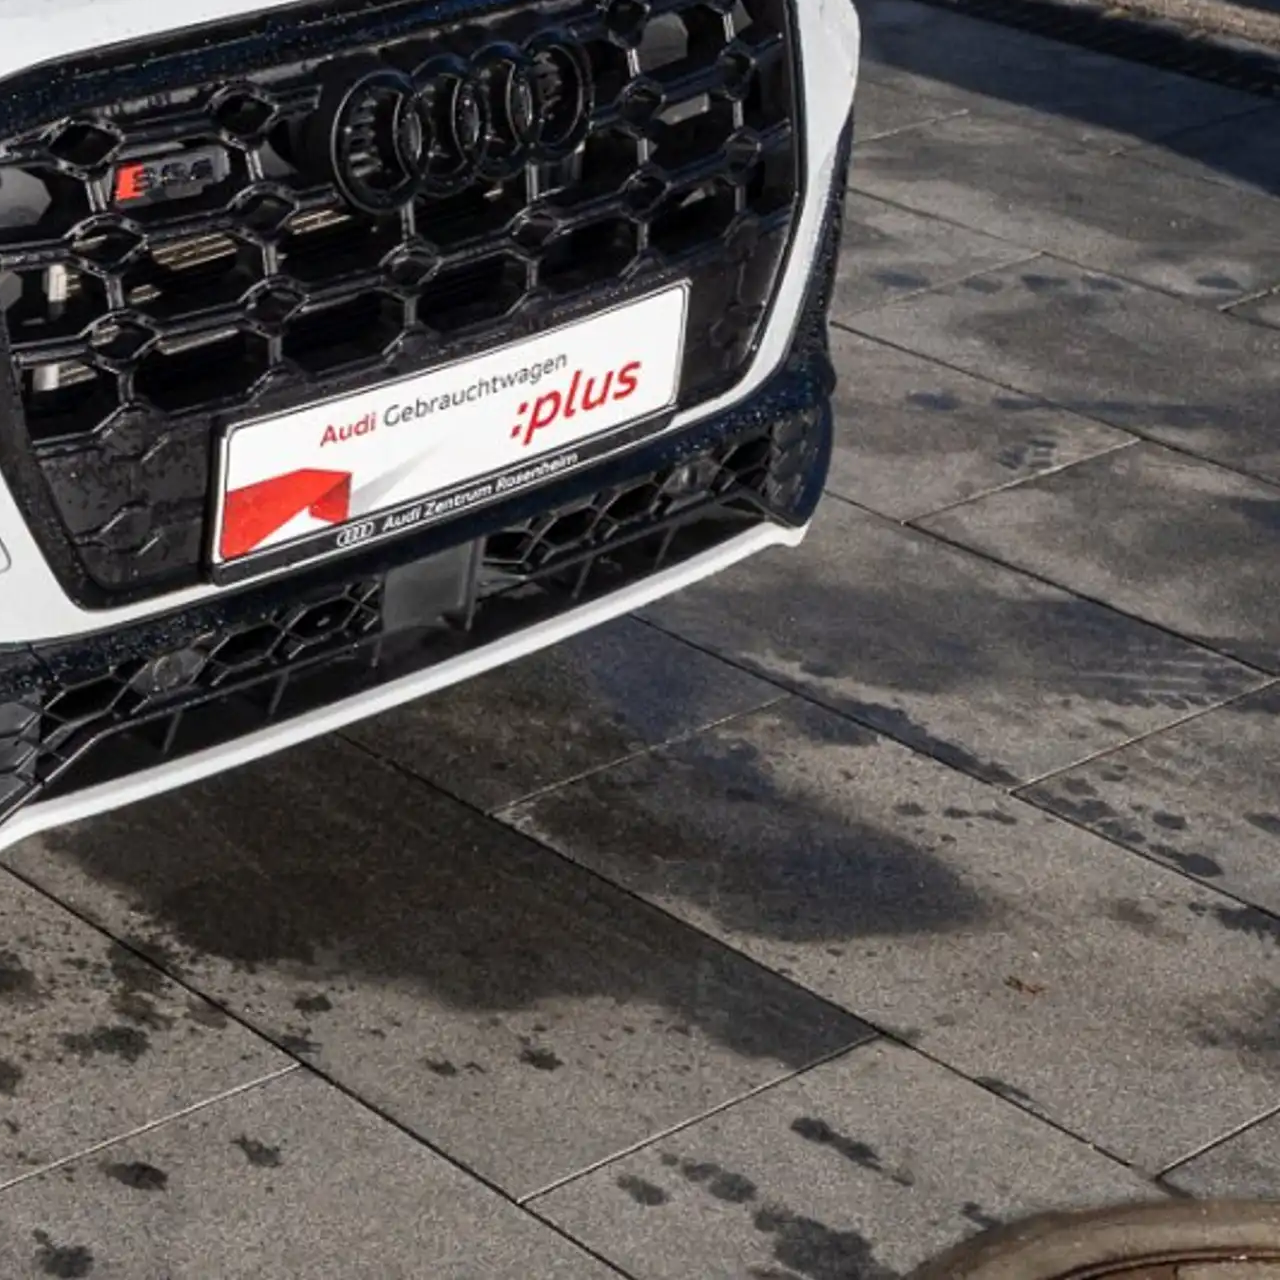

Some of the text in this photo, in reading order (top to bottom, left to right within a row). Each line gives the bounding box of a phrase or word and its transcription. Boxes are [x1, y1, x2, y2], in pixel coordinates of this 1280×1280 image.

[320, 353, 568, 447] Audi Gebrauchtwagen
[382, 453, 579, 532] Audi Zentrum Rosenheim
